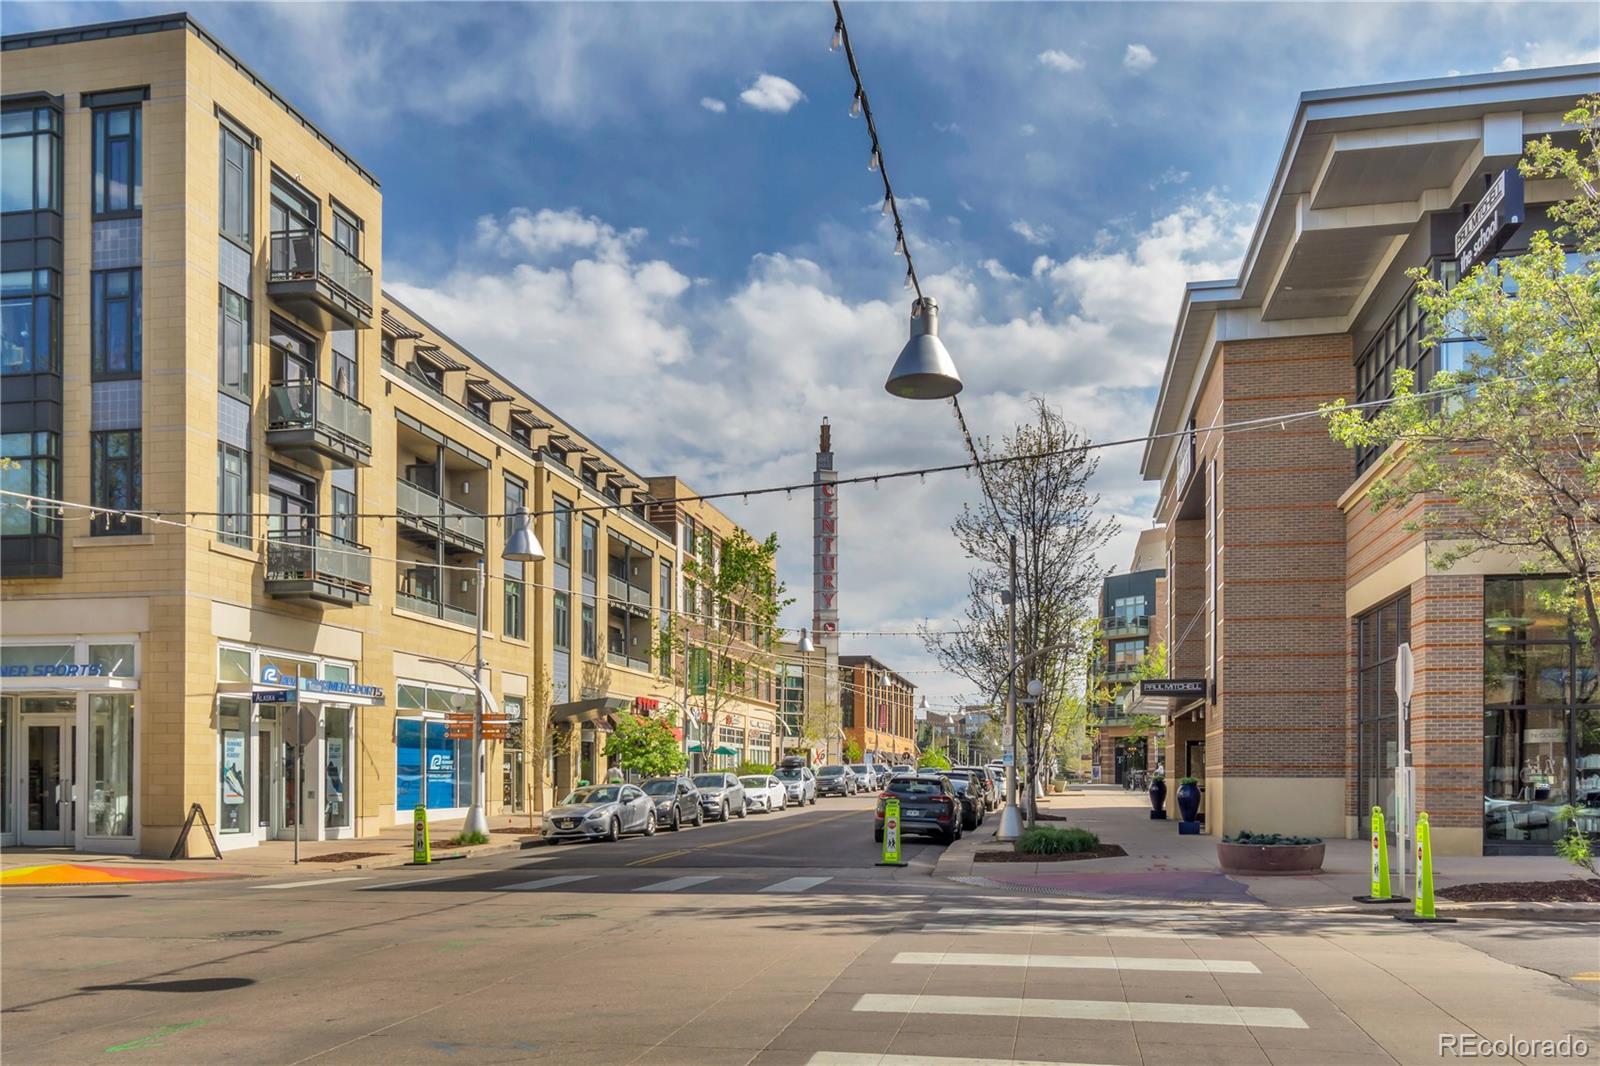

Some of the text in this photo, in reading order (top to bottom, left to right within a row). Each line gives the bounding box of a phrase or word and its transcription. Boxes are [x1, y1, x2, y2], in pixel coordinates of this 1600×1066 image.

[1460, 210, 1497, 273] the school
[822, 482, 836, 608] CENTURY
[32, 663, 103, 677] SPORTS
[1160, 682, 1201, 691] MITCHELL
